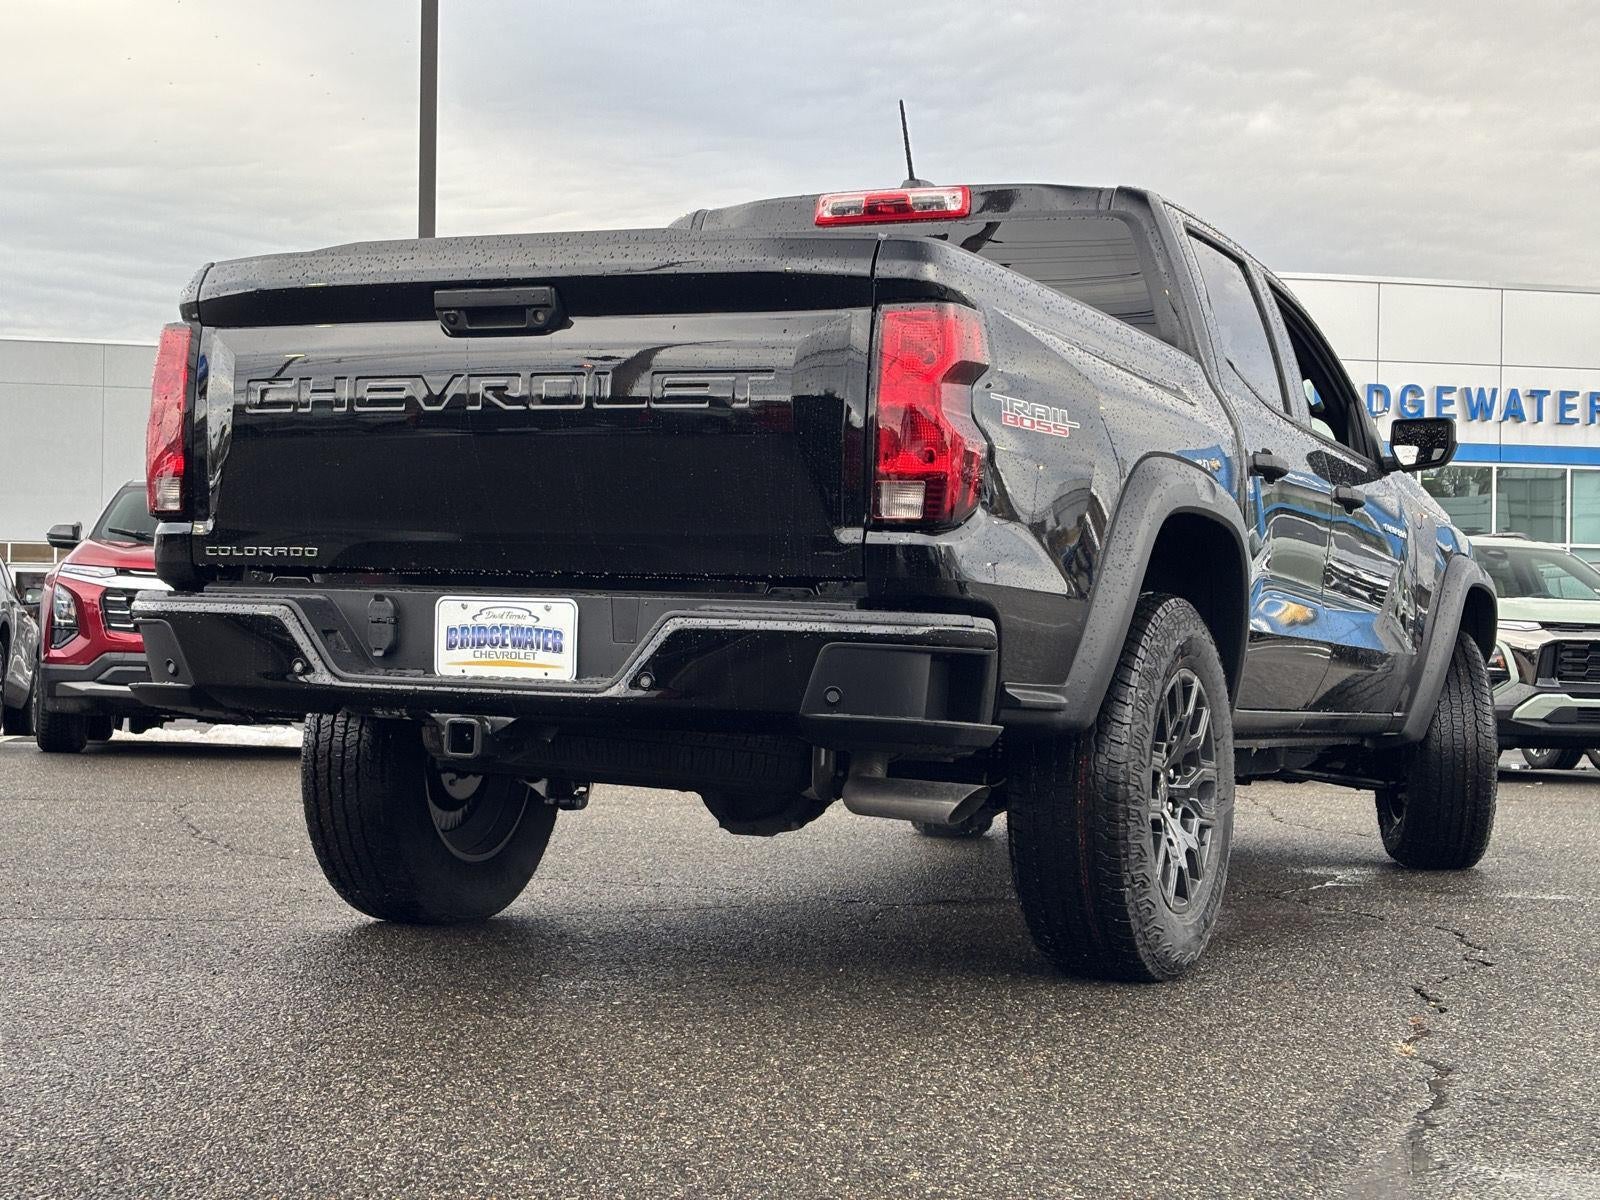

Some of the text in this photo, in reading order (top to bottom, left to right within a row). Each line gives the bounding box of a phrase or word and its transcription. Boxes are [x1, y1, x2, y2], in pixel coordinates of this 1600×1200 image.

[245, 369, 775, 413] CHEVROLET
[990, 392, 1081, 429] TRAIL
[1001, 410, 1070, 438] BOSS
[205, 546, 319, 557] COLORADO
[446, 624, 564, 653] BRIDGEWATER
[473, 650, 537, 660] CHEVROLET
